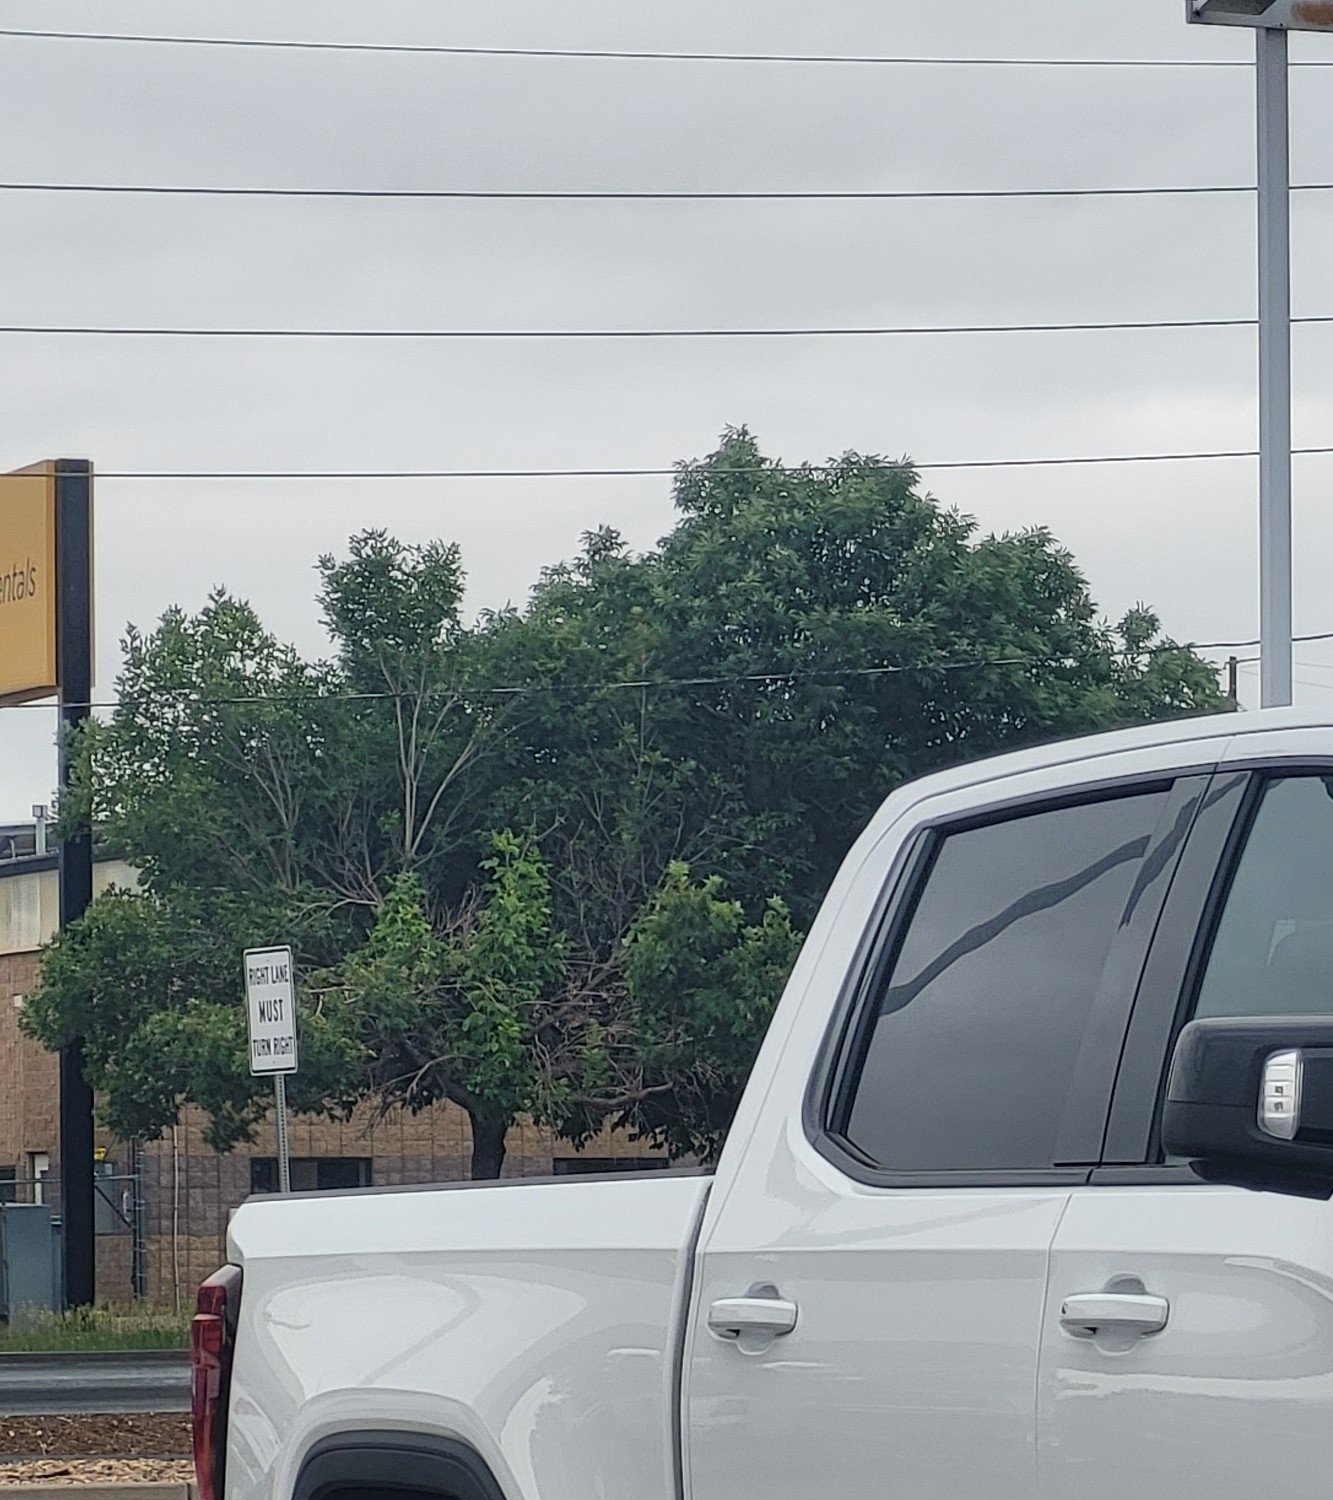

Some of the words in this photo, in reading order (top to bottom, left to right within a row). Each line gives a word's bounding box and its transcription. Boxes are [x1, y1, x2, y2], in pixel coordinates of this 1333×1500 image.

[0, 556, 36, 606] ntals
[249, 967, 270, 985] RIGHT
[271, 964, 289, 984] LANE
[258, 999, 284, 1023] MUST
[253, 1038, 272, 1057] TURN
[273, 1036, 293, 1055] RIGHT
